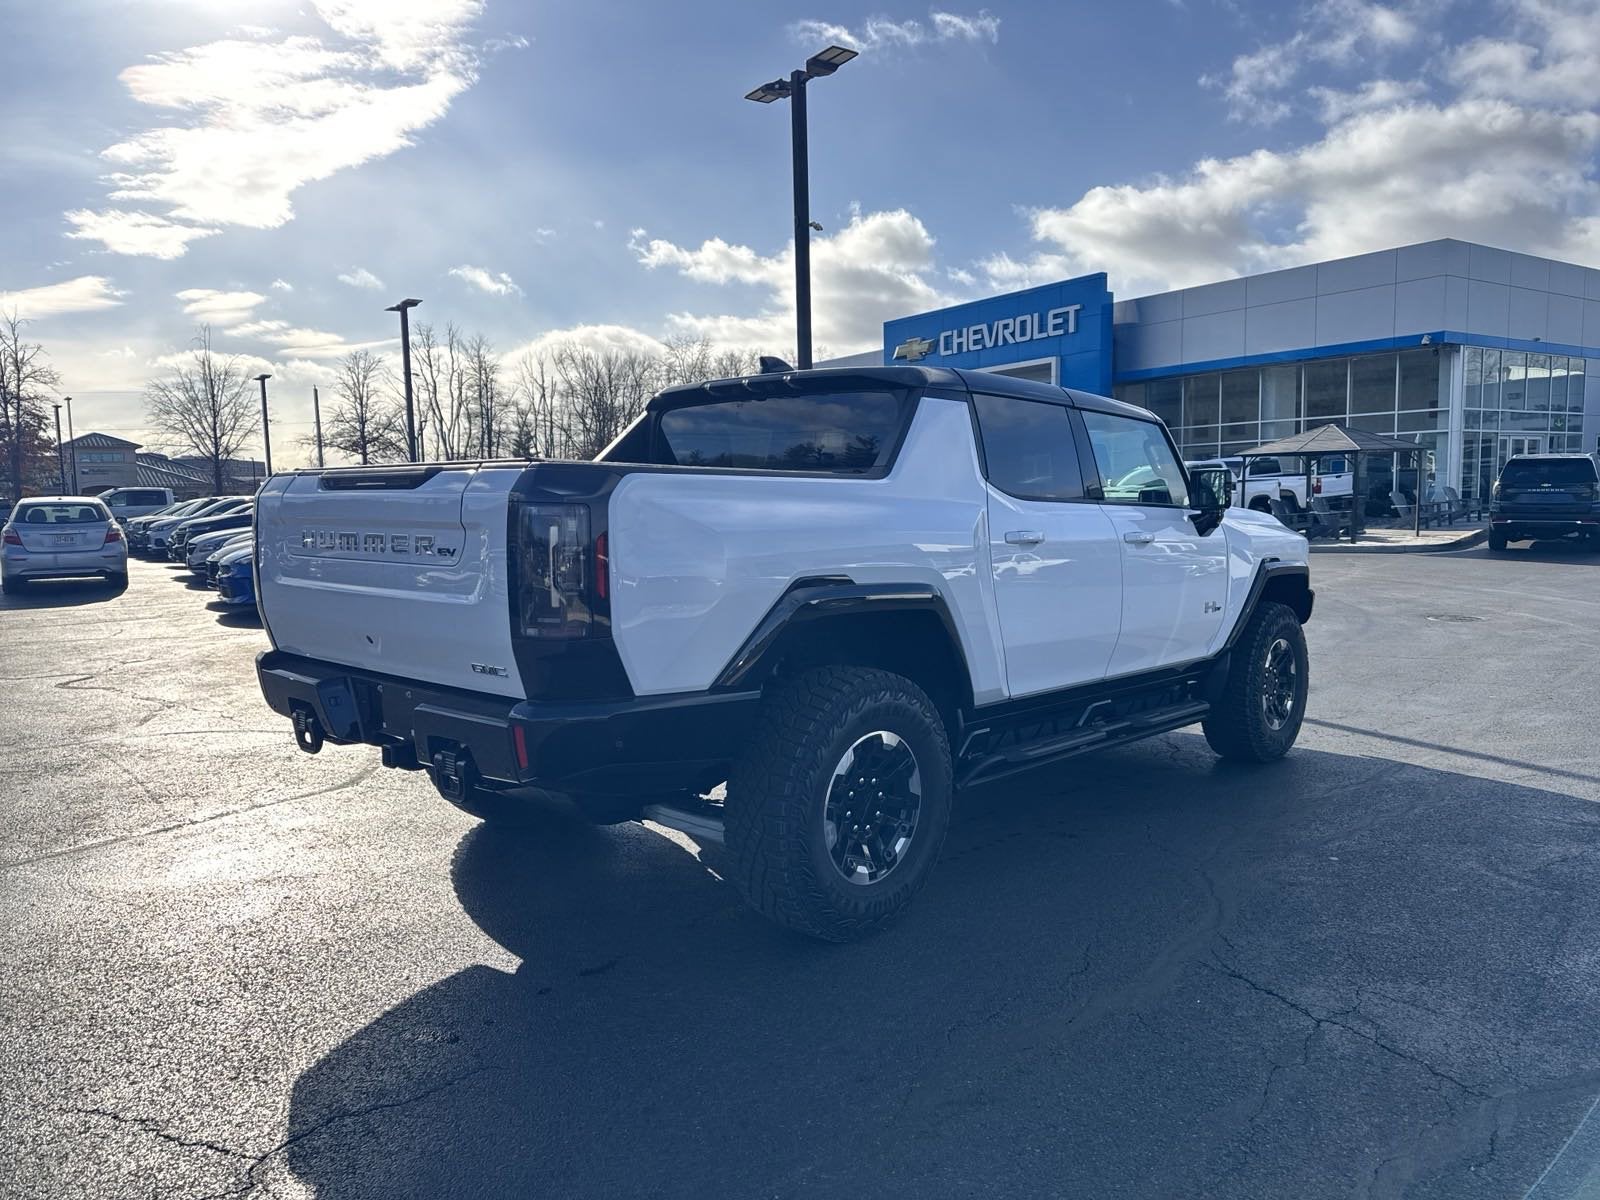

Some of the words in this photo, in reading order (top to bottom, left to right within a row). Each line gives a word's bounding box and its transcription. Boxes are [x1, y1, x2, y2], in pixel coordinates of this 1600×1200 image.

[939, 304, 1081, 356] CHEVROLET
[302, 529, 435, 556] HUMMER
[471, 662, 508, 678] GMC
